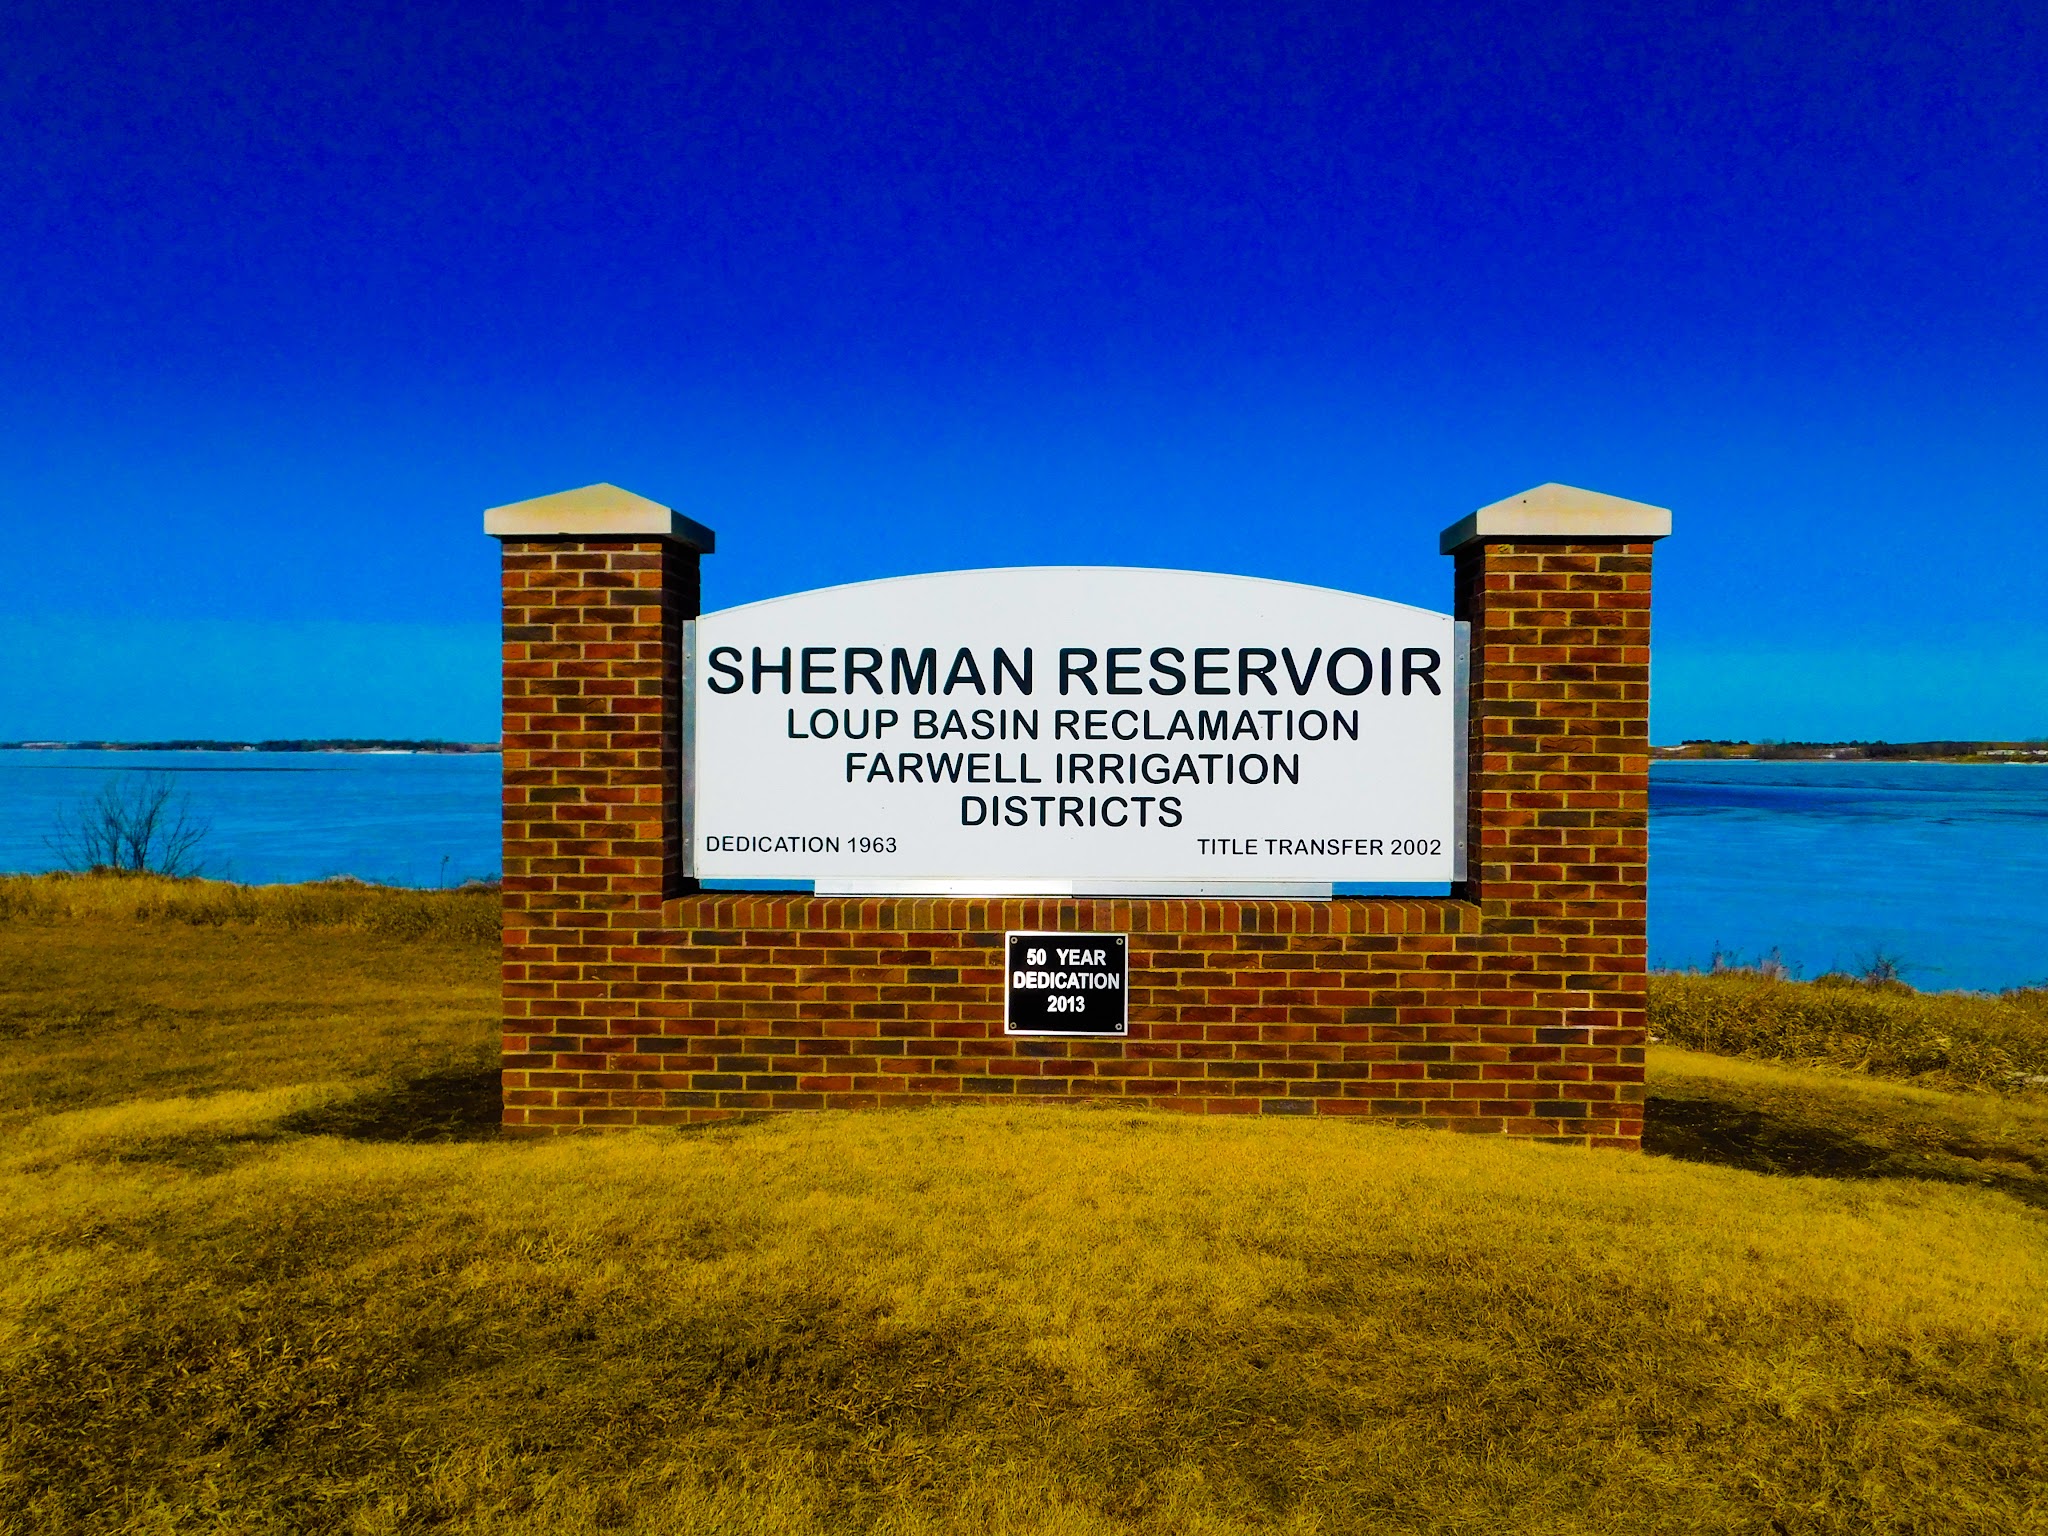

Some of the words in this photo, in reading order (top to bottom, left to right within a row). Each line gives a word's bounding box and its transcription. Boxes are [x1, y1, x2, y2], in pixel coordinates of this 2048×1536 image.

[708, 647, 1032, 695] SHERMAN
[1059, 647, 1442, 695] RESERVOIR
[788, 709, 899, 740] LOUP
[914, 709, 1039, 740] BASIN
[1055, 709, 1359, 741] RECLAMATION
[846, 752, 1041, 784] FARWELL
[1057, 753, 1299, 784] IRRIGATION
[962, 796, 1183, 828] DISTRICTS
[706, 836, 840, 853] DEDICATION
[847, 836, 897, 853] 1963
[1197, 838, 1258, 855] TITLE
[1264, 838, 1383, 856] TRANSFER
[1390, 839, 1441, 856] 2002
[1026, 948, 1047, 966] 50
[1056, 949, 1106, 966] YEAR
[1013, 971, 1120, 989] DEDICATION
[1047, 995, 1085, 1012] 2013
